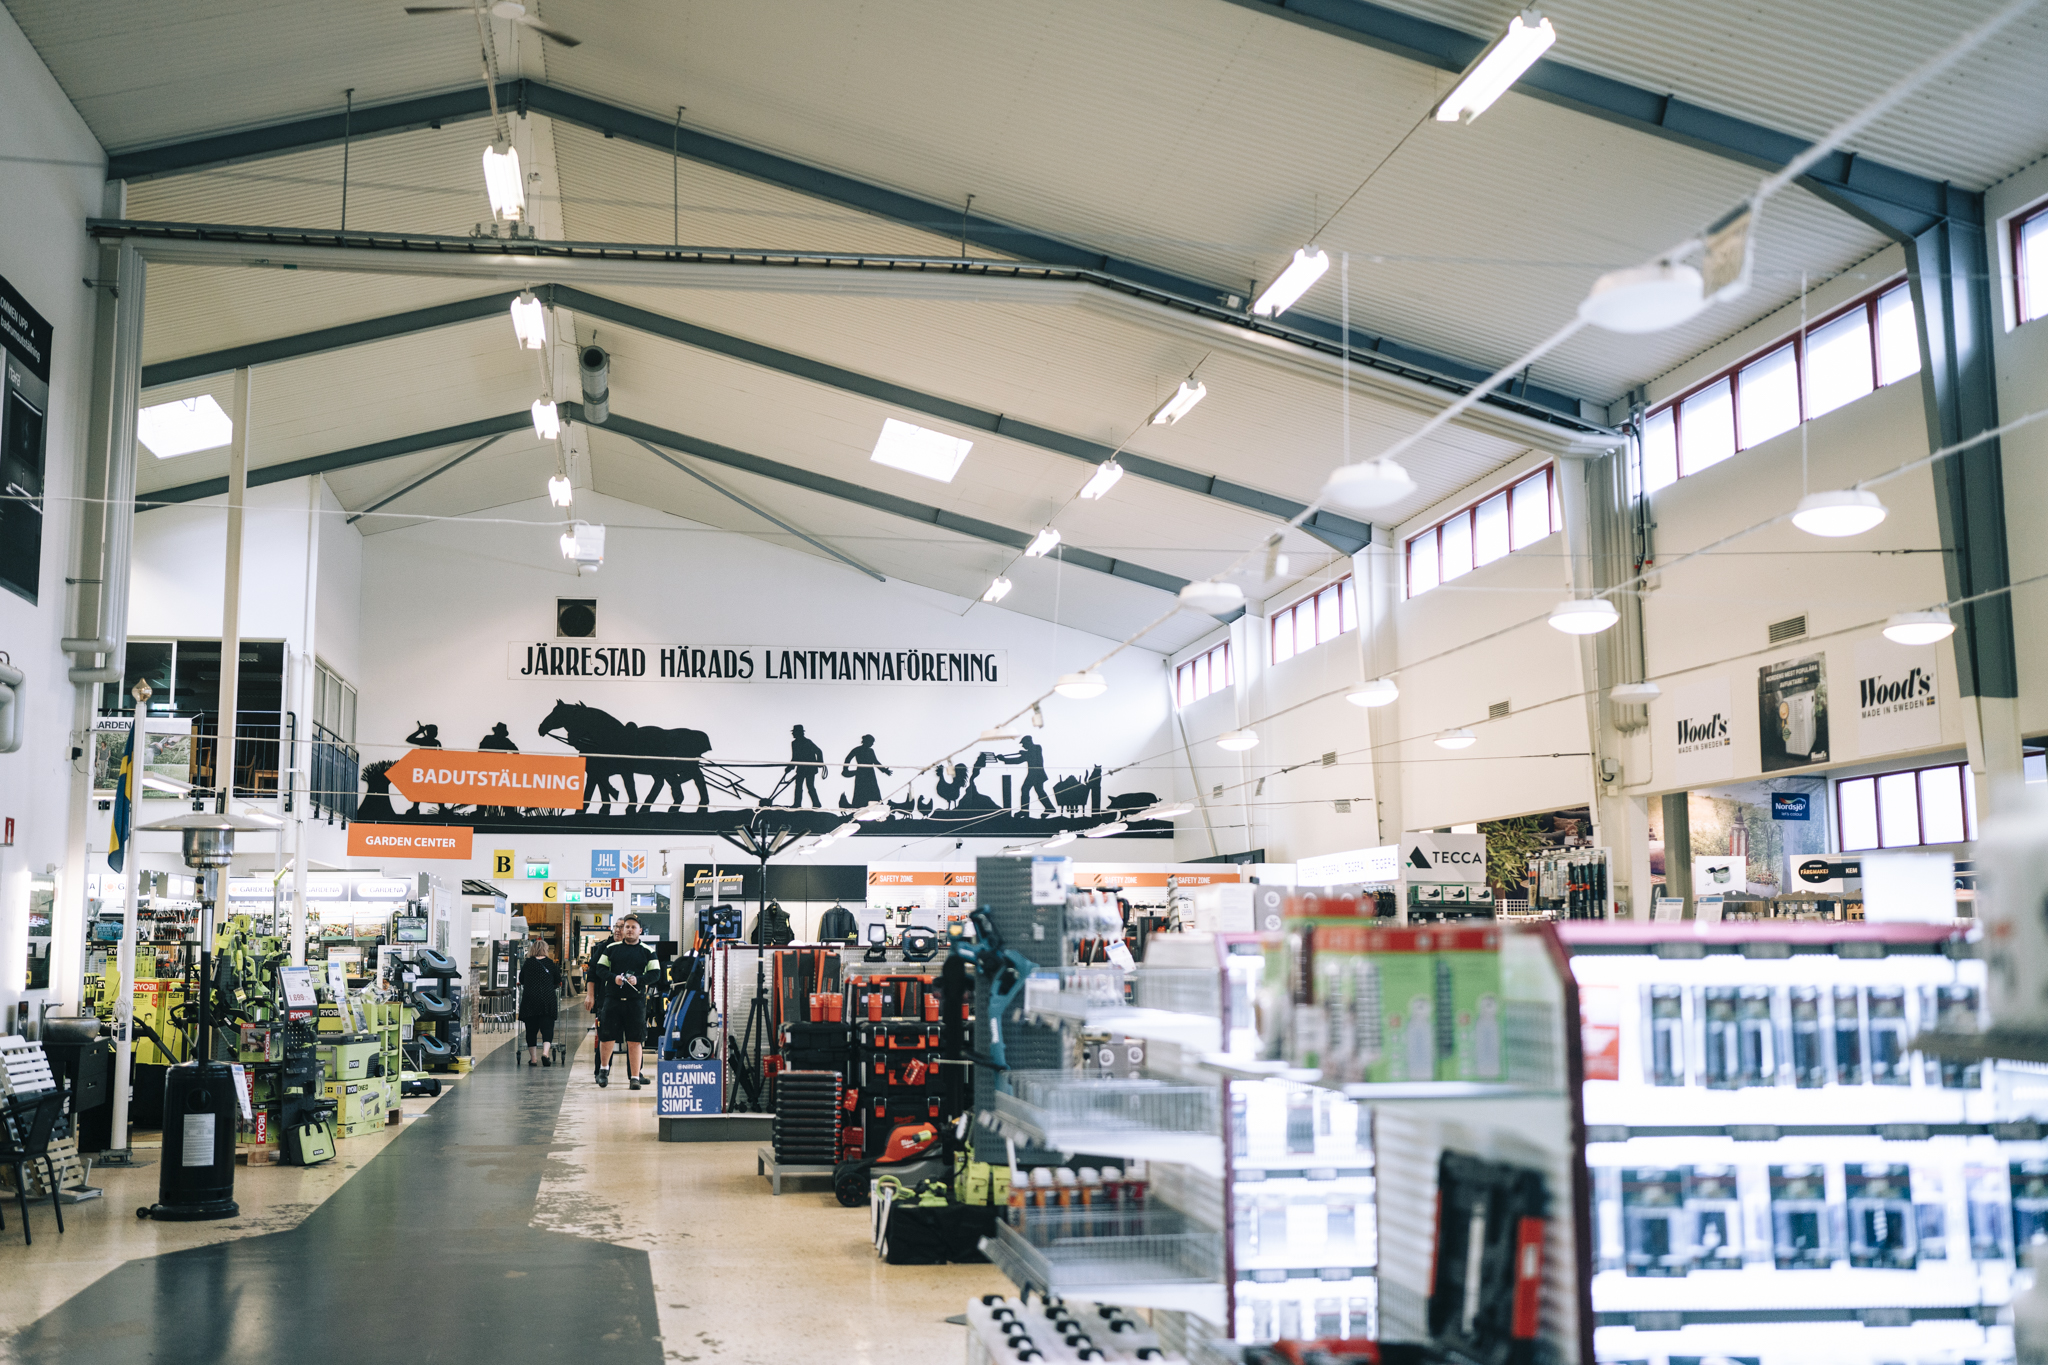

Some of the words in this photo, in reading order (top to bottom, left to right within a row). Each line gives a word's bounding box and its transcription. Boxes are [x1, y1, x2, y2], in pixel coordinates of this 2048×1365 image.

[18, 314, 29, 331] UPP
[521, 643, 645, 677] JÄRRESTAD
[660, 645, 754, 679] HÄRADS
[765, 649, 998, 682] LANTMANNAFÖRENING
[1859, 667, 1932, 708] Wood's
[1861, 708, 1881, 719] MADE
[1883, 706, 1891, 715] IN
[1893, 700, 1925, 713] SWEDEN
[97, 721, 131, 729] ARDEN
[1677, 712, 1728, 745] Wood's
[1678, 745, 1692, 754] MADE
[1700, 741, 1723, 750] SWEDEN
[412, 768, 580, 791] BADUTSTÄLLNING
[1775, 802, 1803, 812] Nordsjö
[365, 835, 412, 847] GARDEN
[414, 837, 456, 848] CENTER
[597, 854, 616, 867] JHL
[1432, 851, 1482, 864] TECCA
[496, 856, 511, 873] B
[879, 875, 899, 883] SAFETY
[900, 875, 913, 883] ZONE
[955, 875, 975, 883] SAFETY
[1104, 876, 1123, 884] SAFETY
[1124, 876, 1138, 884] ZONE
[1178, 876, 1197, 884] SAFETY
[1198, 876, 1211, 884] ZONE
[545, 886, 557, 898] C
[134, 983, 158, 991] RYOBI
[662, 1071, 716, 1085] CLEANING
[662, 1085, 694, 1098] MADE
[662, 1099, 703, 1112] SIMPLE
[258, 1114, 266, 1142] RYOBI
